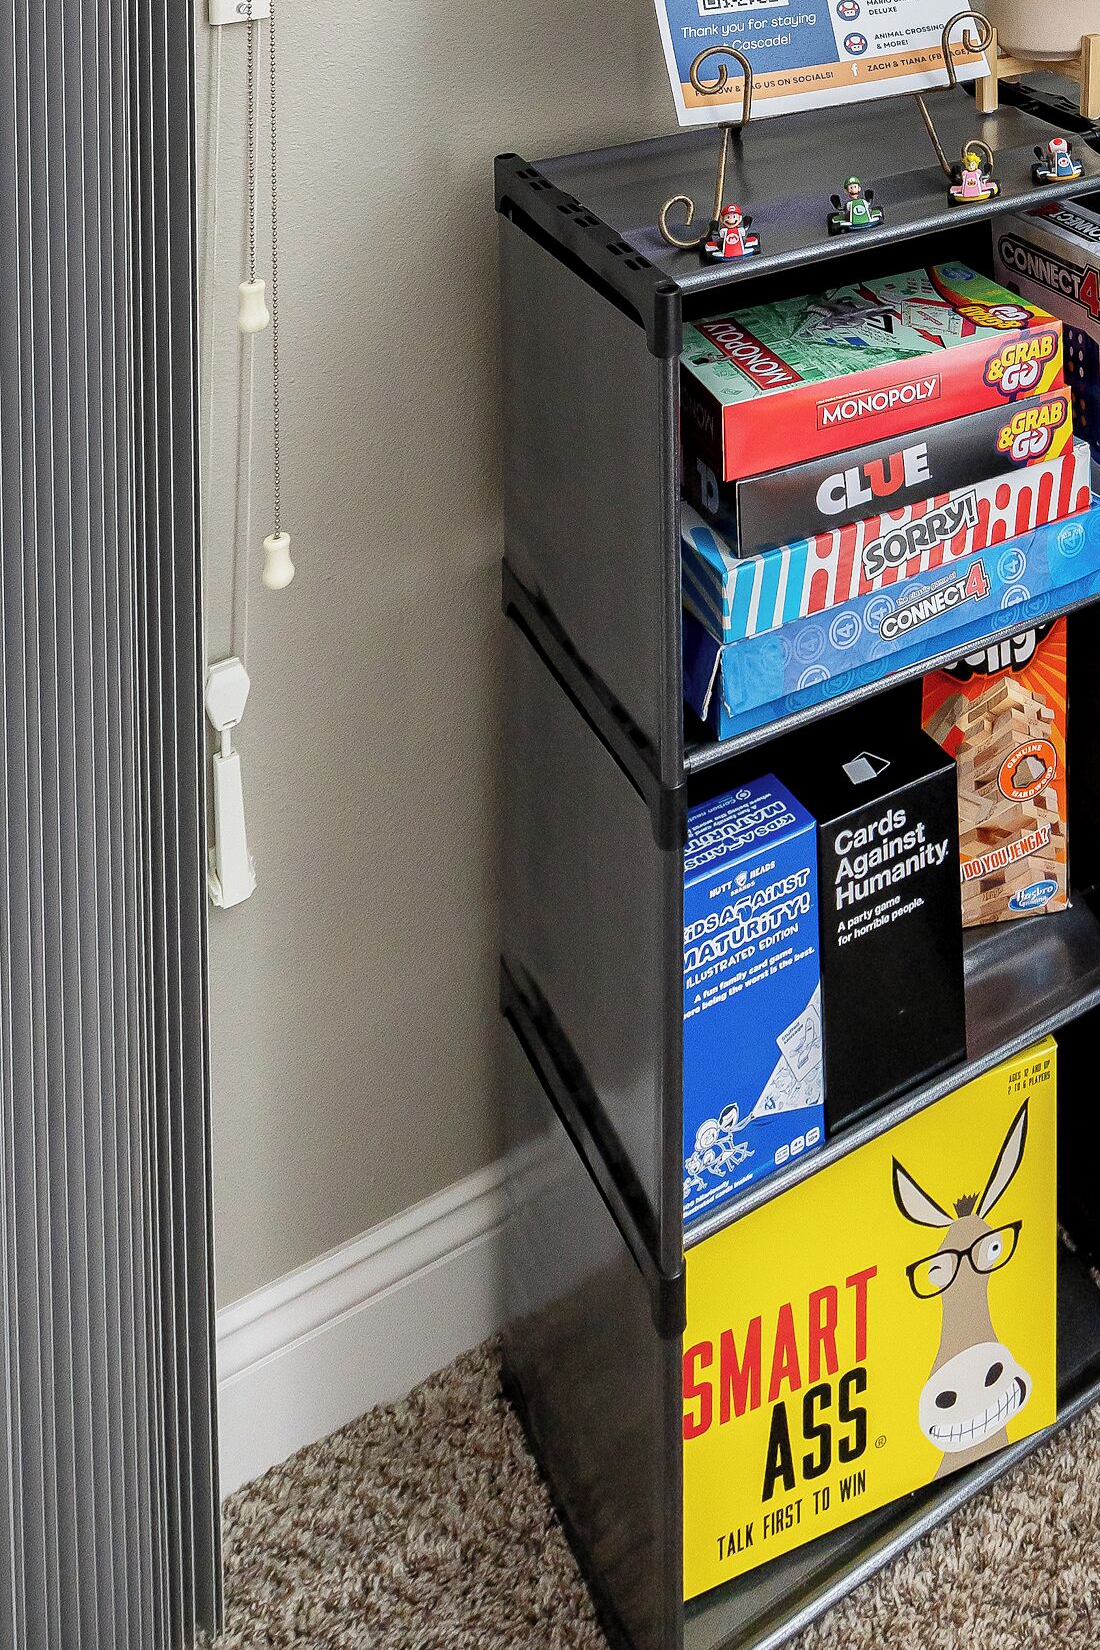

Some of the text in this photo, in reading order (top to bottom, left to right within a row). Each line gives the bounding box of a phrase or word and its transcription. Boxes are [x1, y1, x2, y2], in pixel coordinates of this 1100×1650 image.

[680, 12, 817, 39] Thank you for staying
[868, 6, 898, 16] DELUXE
[874, 23, 945, 40] ANIMAL CROSSING
[731, 32, 792, 52] Cascade!
[867, 52, 942, 73] ZACH & TIANA (FB
[876, 39, 909, 50] & MORE!
[763, 71, 834, 88] US ON SOCIALS!
[1000, 239, 1081, 301] CONNECT
[702, 322, 794, 385] MONOPOLY
[1001, 335, 1054, 367] GRAB
[987, 359, 1039, 391] & GO
[821, 377, 938, 426] MONOPOLY
[1011, 401, 1063, 434] GRAB
[997, 426, 1049, 458] & GO
[816, 442, 930, 516] CLUE
[865, 494, 977, 575] SORRY!
[881, 562, 987, 637] CONNECT 4
[1007, 744, 1043, 769] GENUINE
[1010, 766, 1053, 798] HARDWOOD
[754, 813, 796, 837] KIDS
[834, 808, 907, 856] Cards
[834, 822, 926, 885] Against
[835, 838, 949, 911] Humanity.
[963, 828, 1050, 878] DO YOU JENGA?
[719, 867, 811, 926] AGAINST
[1015, 883, 1055, 902] Hasbro
[837, 895, 901, 934] A party game
[837, 895, 925, 947] for horrible people.
[685, 922, 799, 989] ILLUSTRATED EDITION
[694, 947, 794, 1004] A fun family card game
[702, 946, 815, 1009] being the worst is the best.
[1008, 1062, 1042, 1084] AGES AND
[1014, 1070, 1051, 1093] TO PLAYERS
[682, 1264, 878, 1441] SMART
[761, 1365, 868, 1504] ASS
[716, 1468, 867, 1562] TALK FIRST TO WIN
